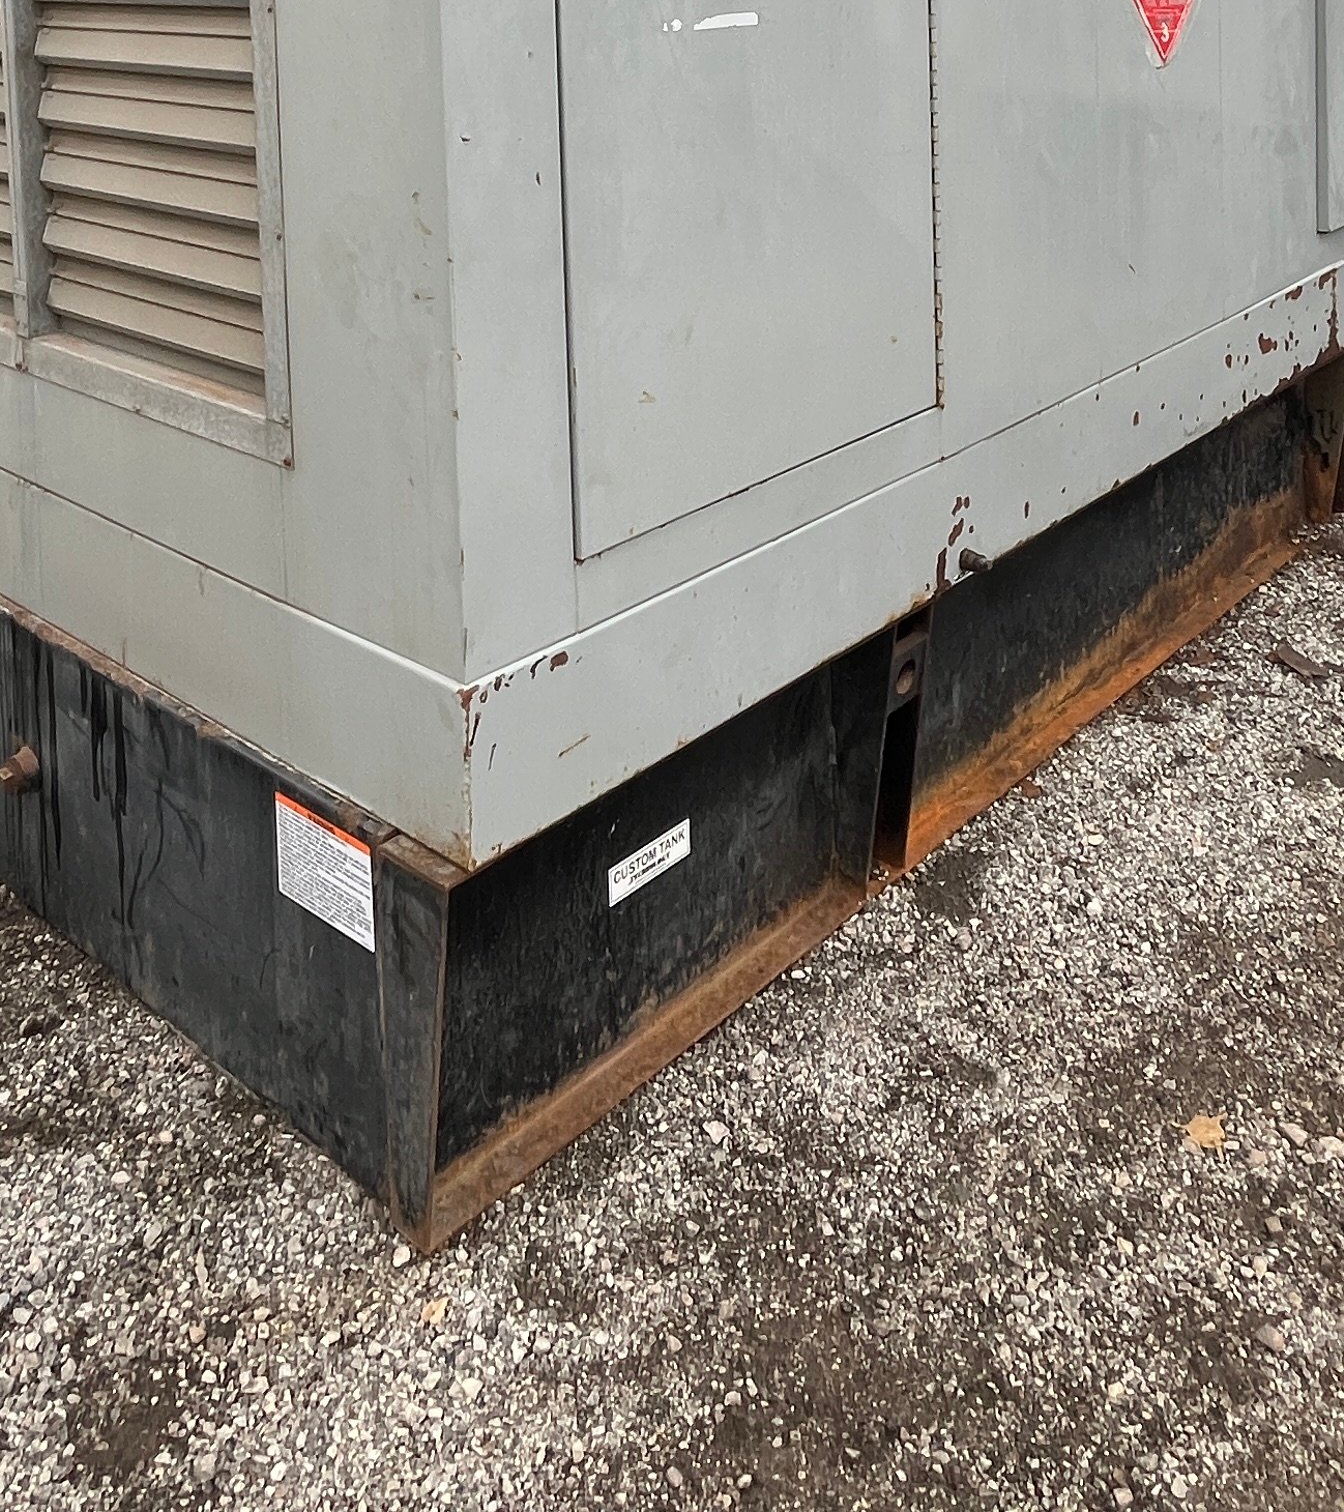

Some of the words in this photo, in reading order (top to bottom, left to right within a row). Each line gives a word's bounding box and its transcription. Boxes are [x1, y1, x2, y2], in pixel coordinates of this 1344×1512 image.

[1160, 21, 1170, 43] 3
[613, 847, 657, 884] CUSTOM
[659, 828, 685, 854] TANK
